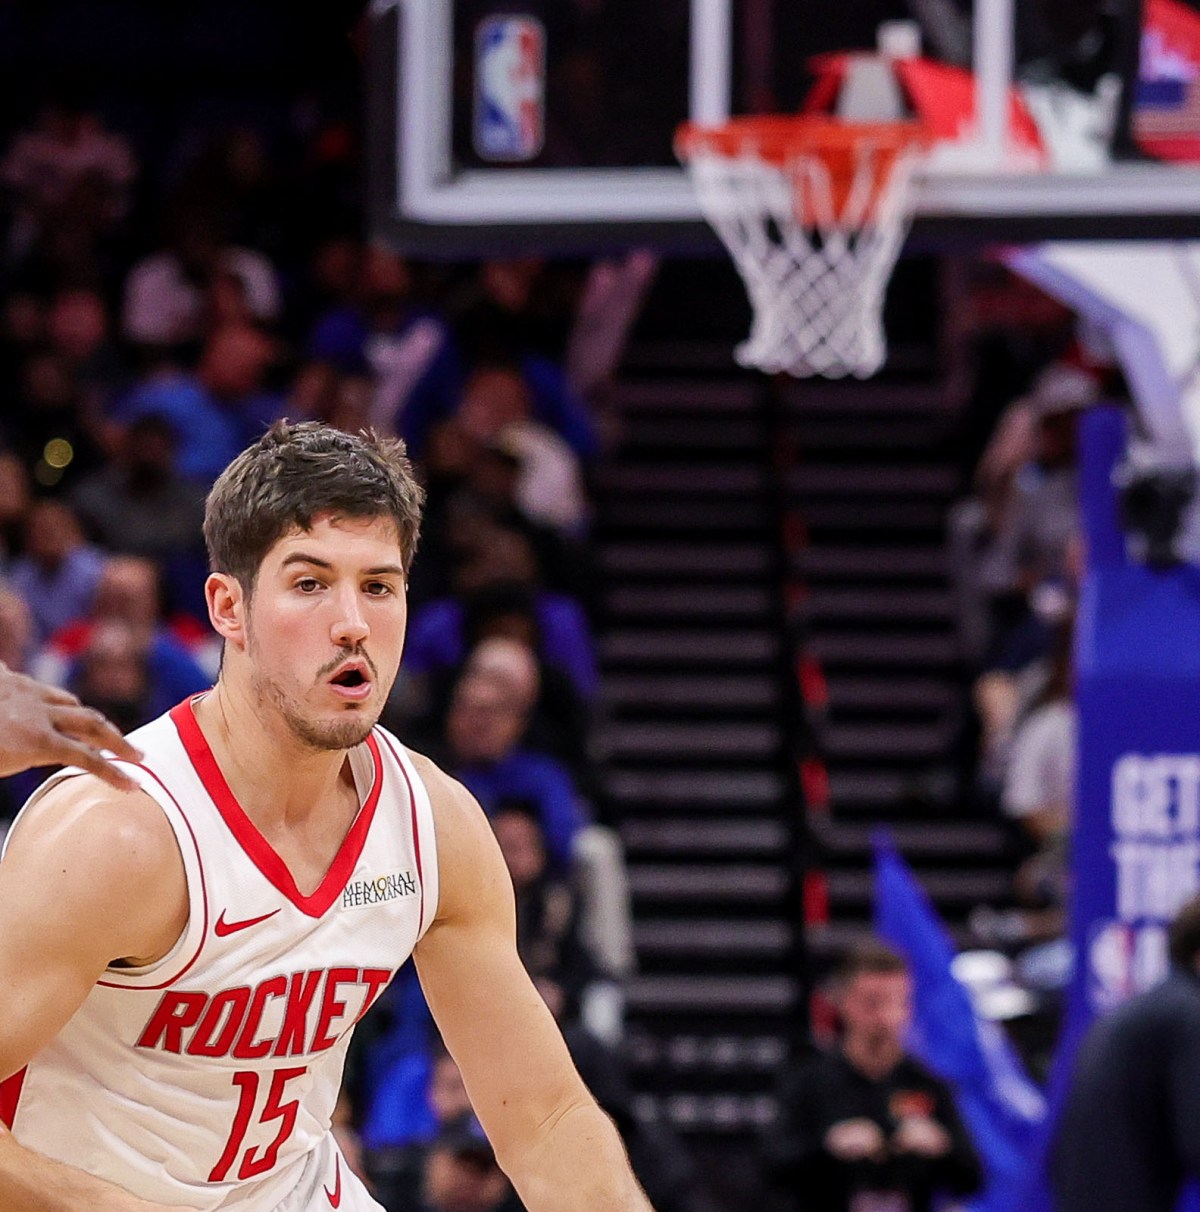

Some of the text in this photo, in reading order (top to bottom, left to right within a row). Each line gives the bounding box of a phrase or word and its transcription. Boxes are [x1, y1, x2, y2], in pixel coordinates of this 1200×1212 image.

[1110, 752, 1200, 838] GET
[343, 882, 416, 908] HERMANN
[344, 871, 416, 896] MEMORIAL
[207, 1065, 308, 1183] 15
